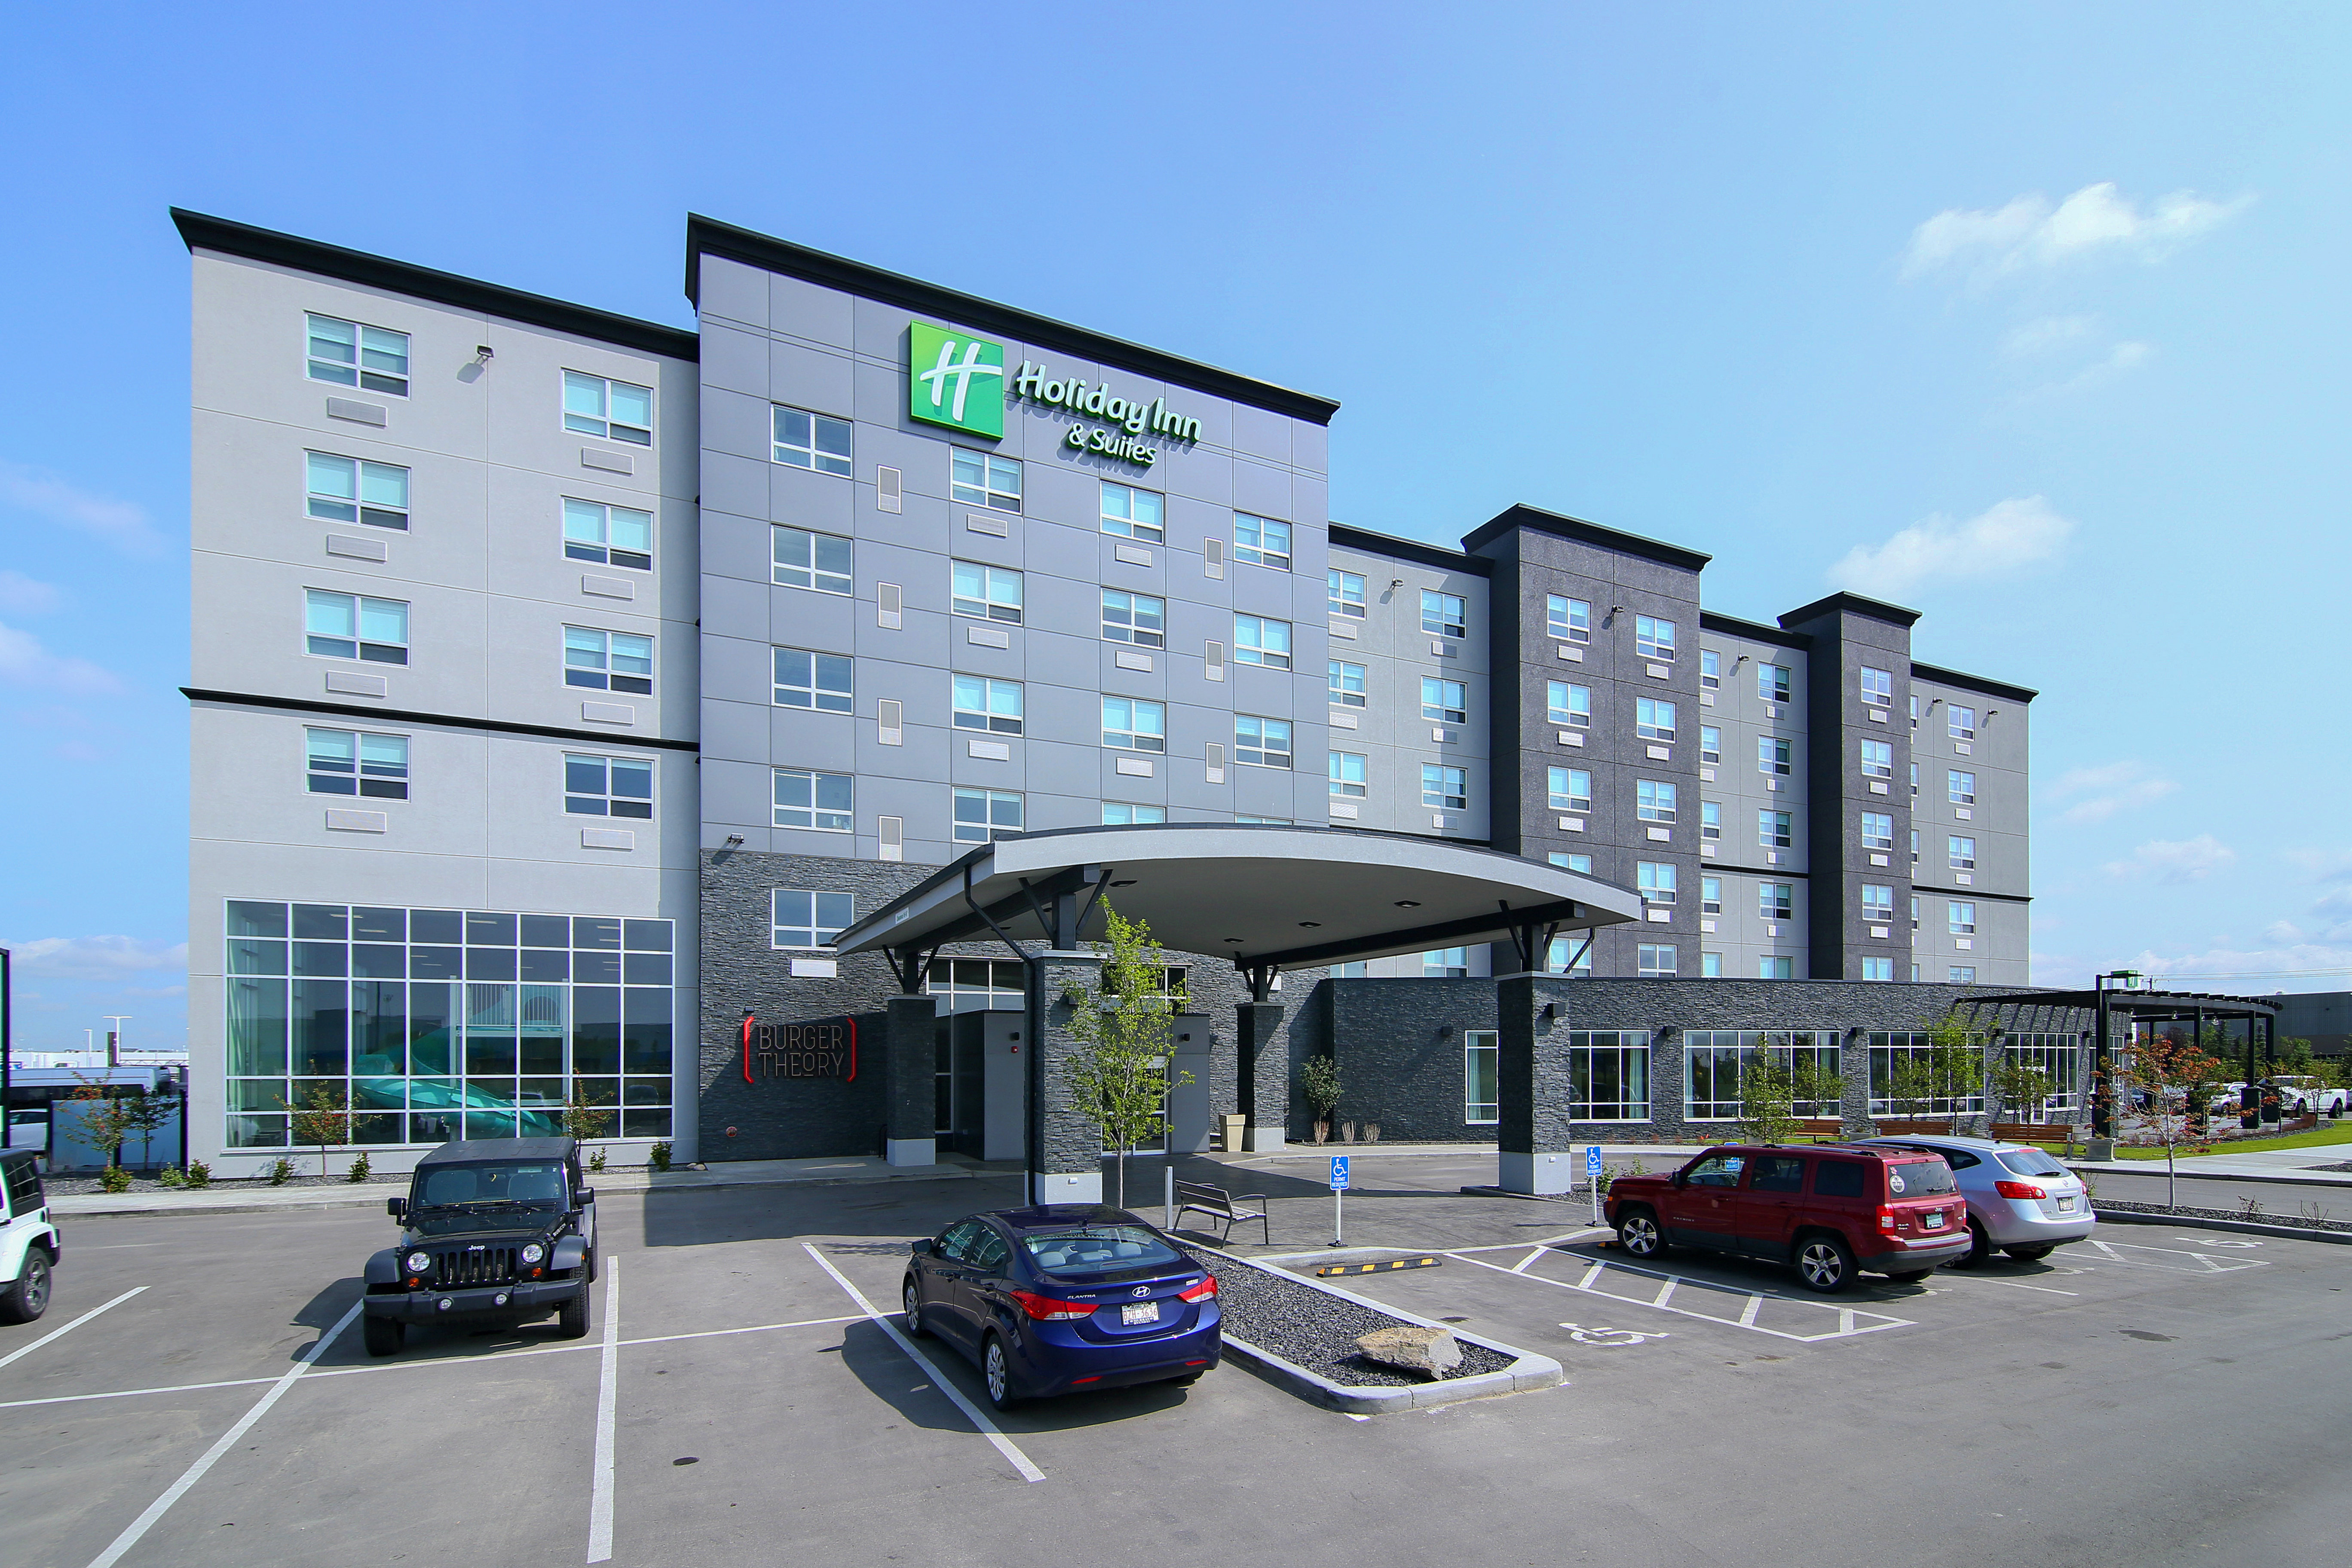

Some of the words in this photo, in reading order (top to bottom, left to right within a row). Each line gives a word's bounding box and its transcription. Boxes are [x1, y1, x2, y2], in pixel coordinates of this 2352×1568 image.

[1016, 360, 1149, 433] Holiday
[1153, 396, 1203, 441] Inn
[1069, 423, 1086, 447] &
[1090, 429, 1157, 465] Suites
[758, 1025, 843, 1050] BURGER
[758, 1053, 844, 1076] THEORY
